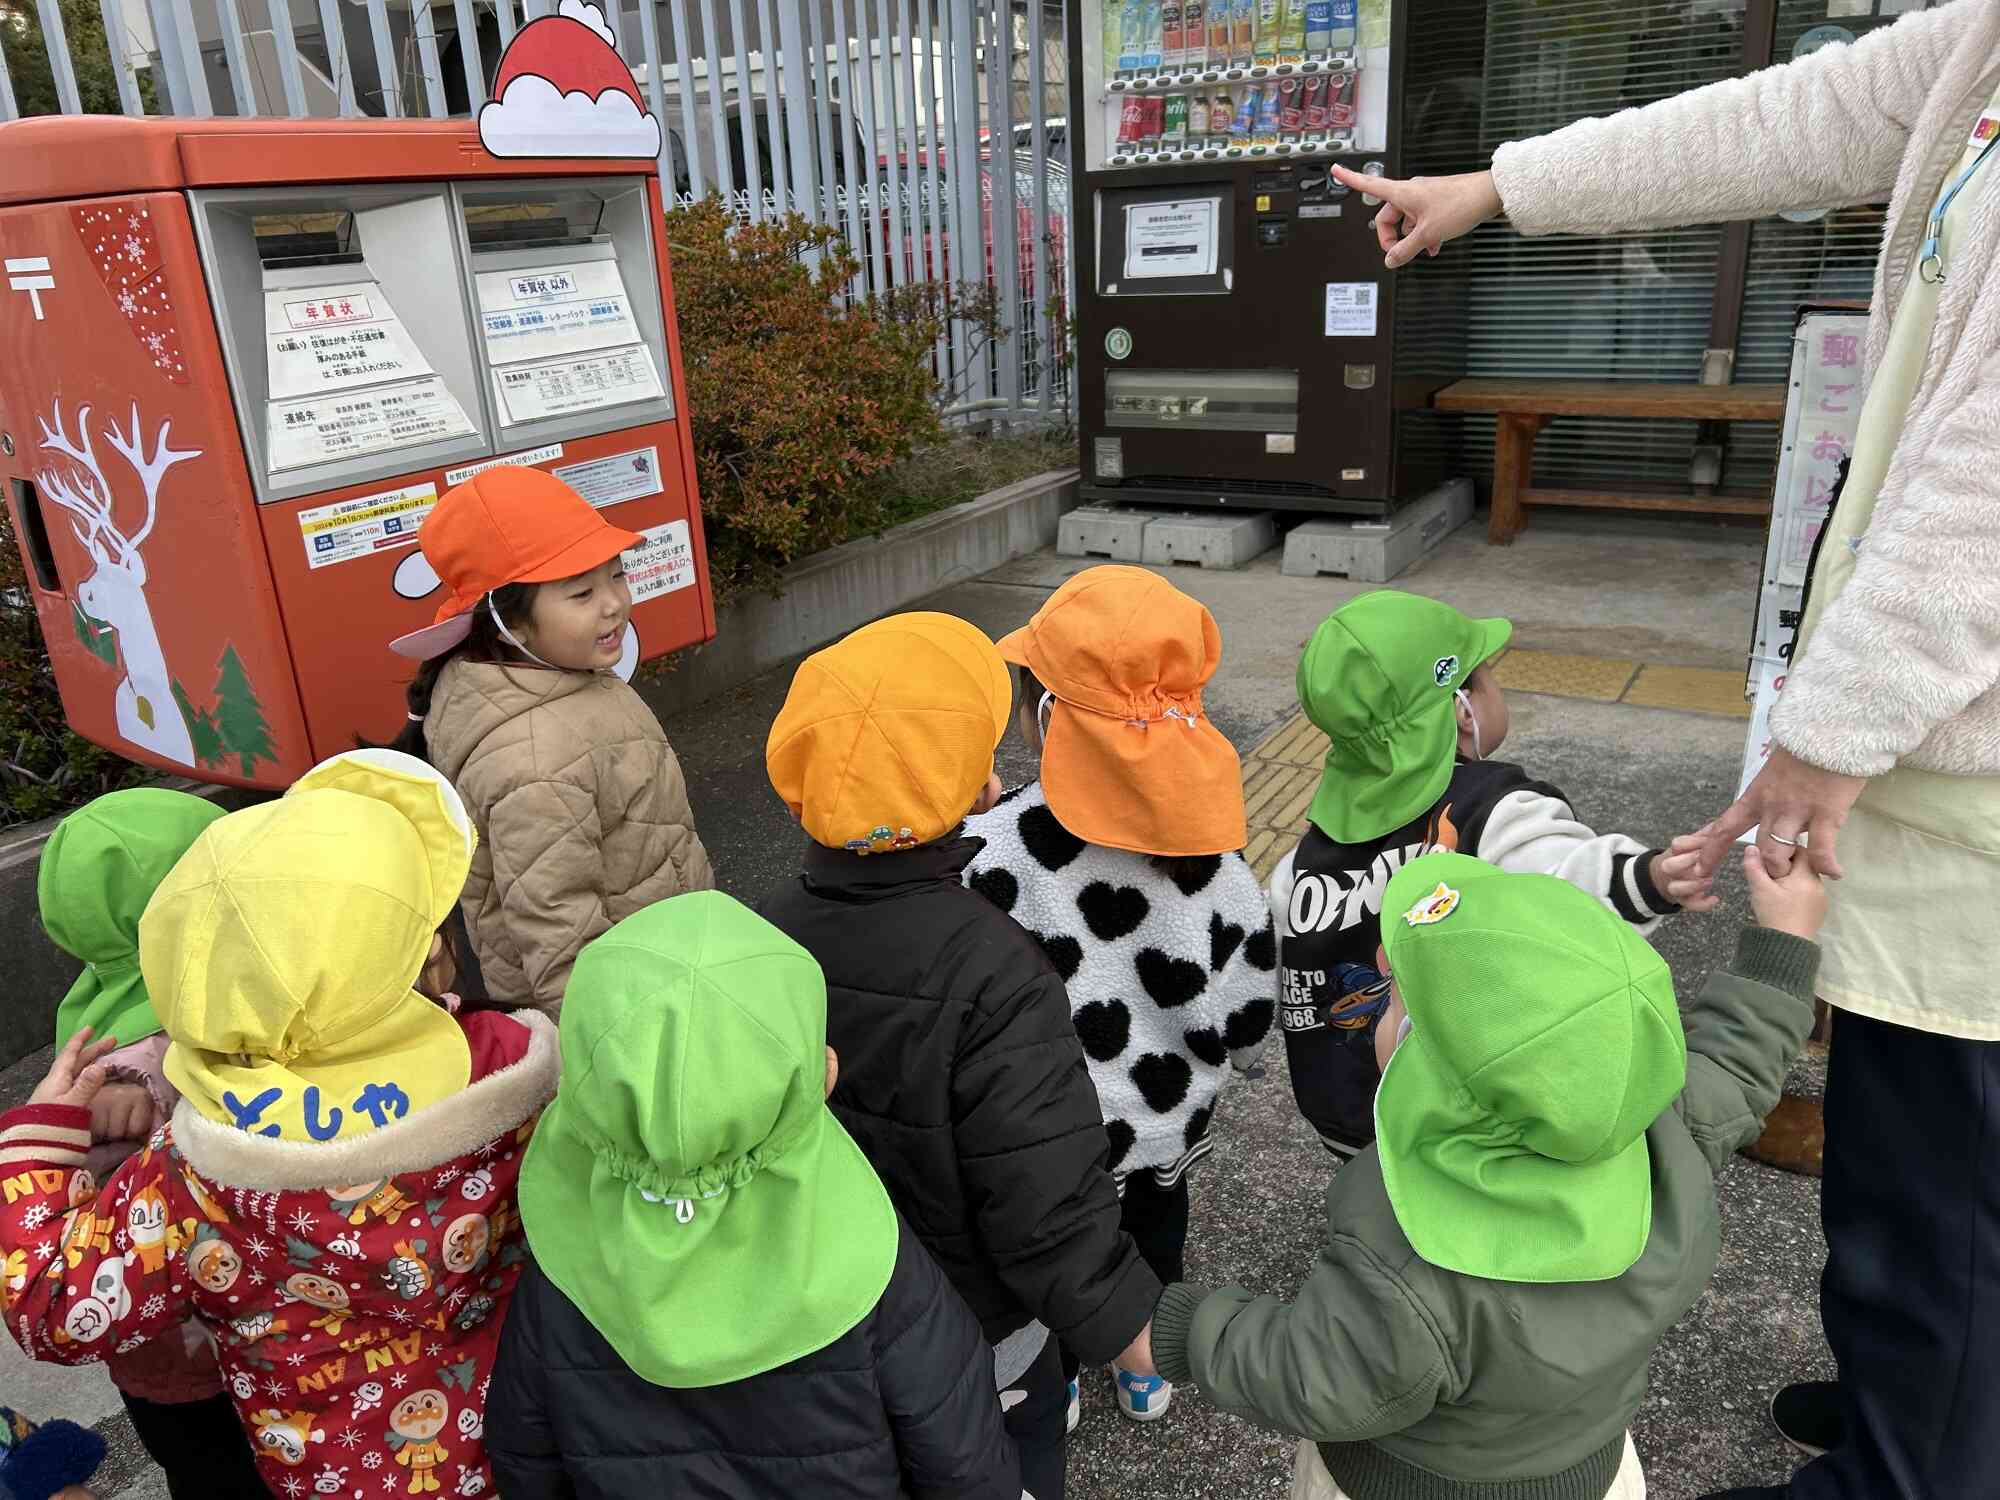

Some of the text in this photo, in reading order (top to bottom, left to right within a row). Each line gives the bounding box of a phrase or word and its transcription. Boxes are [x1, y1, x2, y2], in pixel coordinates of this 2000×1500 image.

[518, 281, 548, 296] 年賀状
[305, 302, 354, 321] 年賀状
[284, 410, 316, 425] 連絡先
[623, 544, 685, 570] ありがとうございます
[636, 573, 681, 596] お入れ願います
[1301, 969, 1326, 987] TO
[223, 1081, 410, 1141] としや
